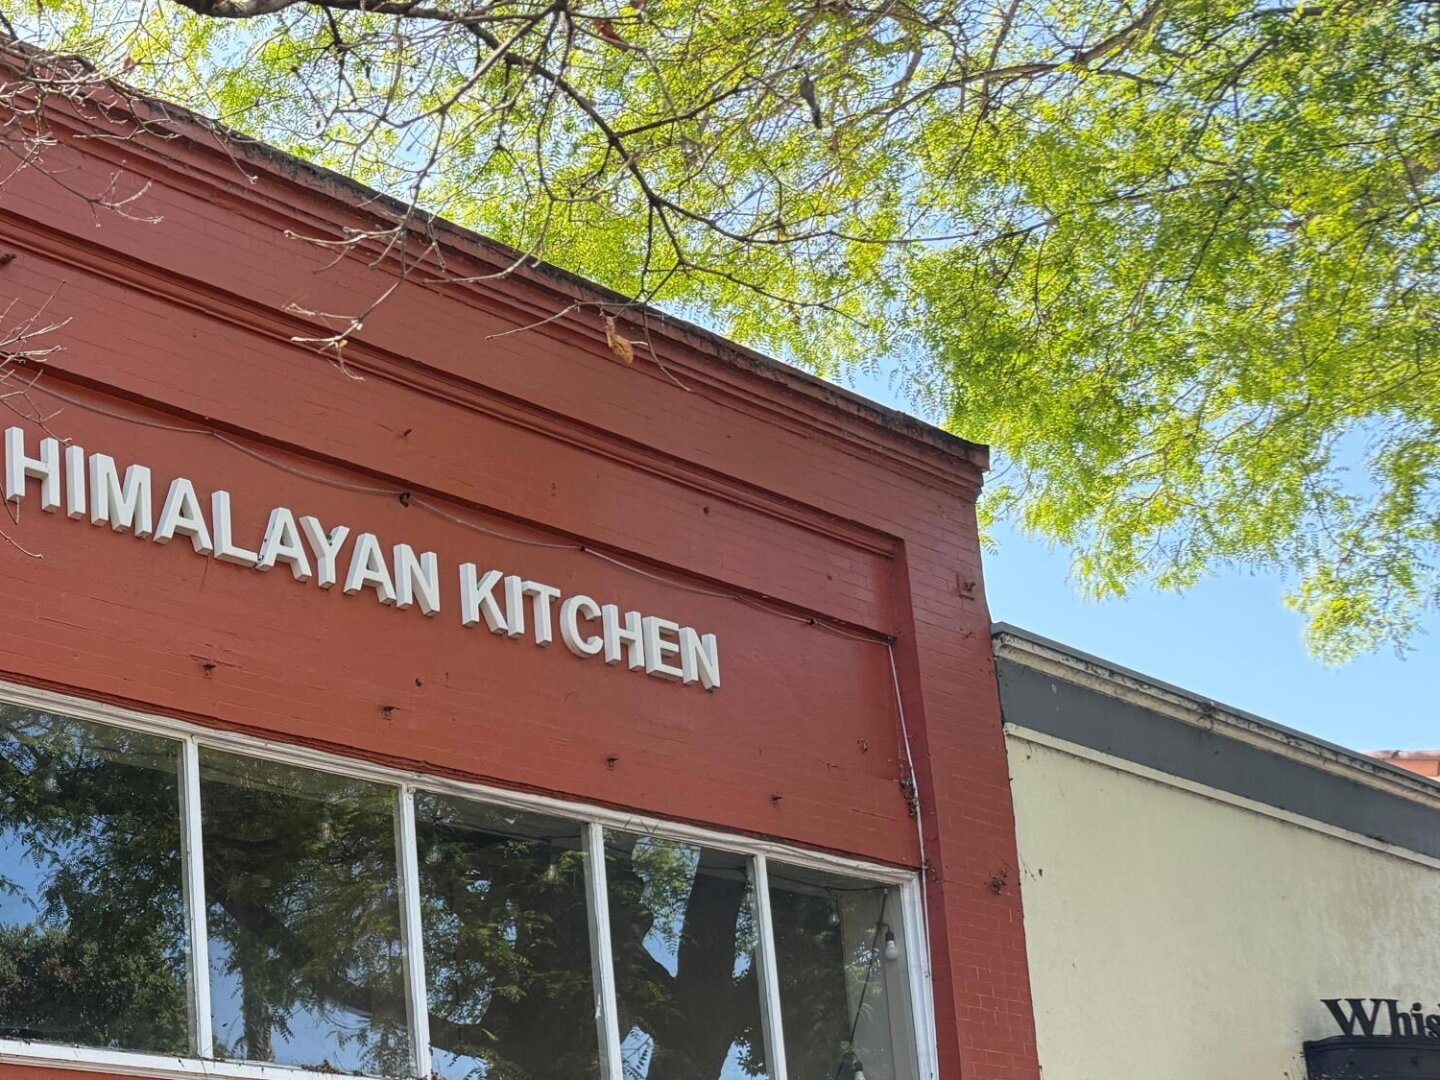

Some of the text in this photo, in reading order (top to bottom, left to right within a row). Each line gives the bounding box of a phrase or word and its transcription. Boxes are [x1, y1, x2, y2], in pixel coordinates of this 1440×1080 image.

[5, 426, 721, 691] HIMALAYAN KITCHEN
[1320, 998, 1440, 1037] Whis
